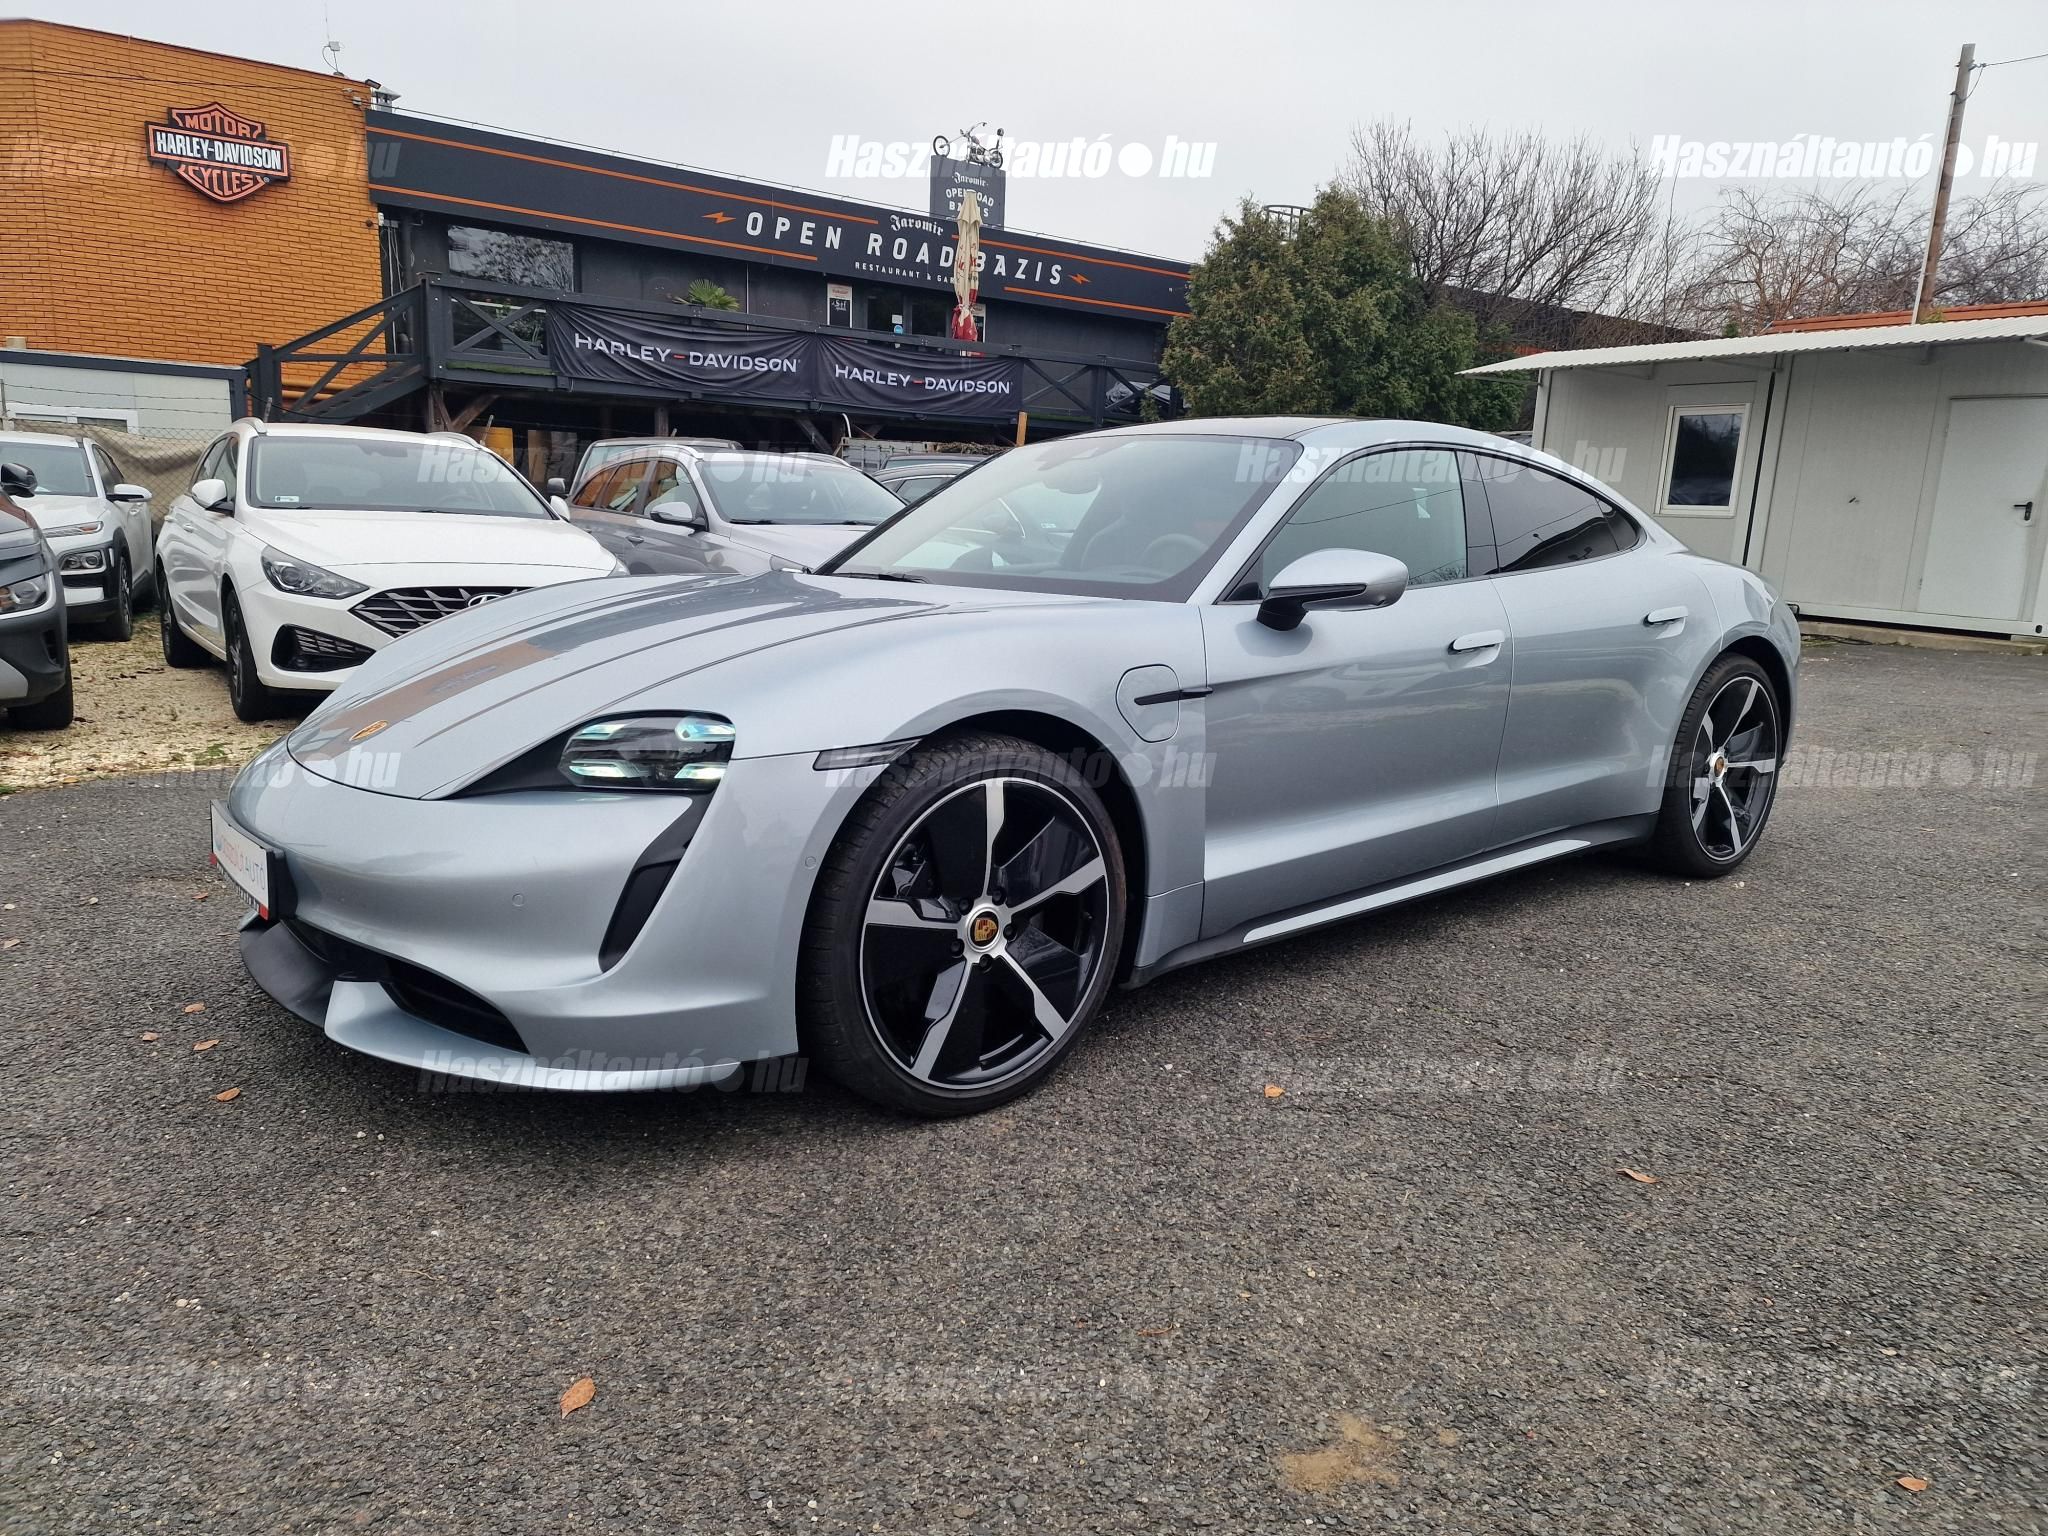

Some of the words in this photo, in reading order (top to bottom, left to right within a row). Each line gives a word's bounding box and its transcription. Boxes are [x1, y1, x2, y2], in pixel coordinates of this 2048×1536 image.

[184, 111, 251, 139] MOTOR
[156, 131, 282, 170] HARLEY-DAVIDSON
[188, 165, 254, 196] CYCLES
[746, 211, 842, 250] OPEN
[867, 233, 955, 268] ROAD
[889, 214, 944, 236] Jaromir
[855, 261, 920, 279] RESTAURANT
